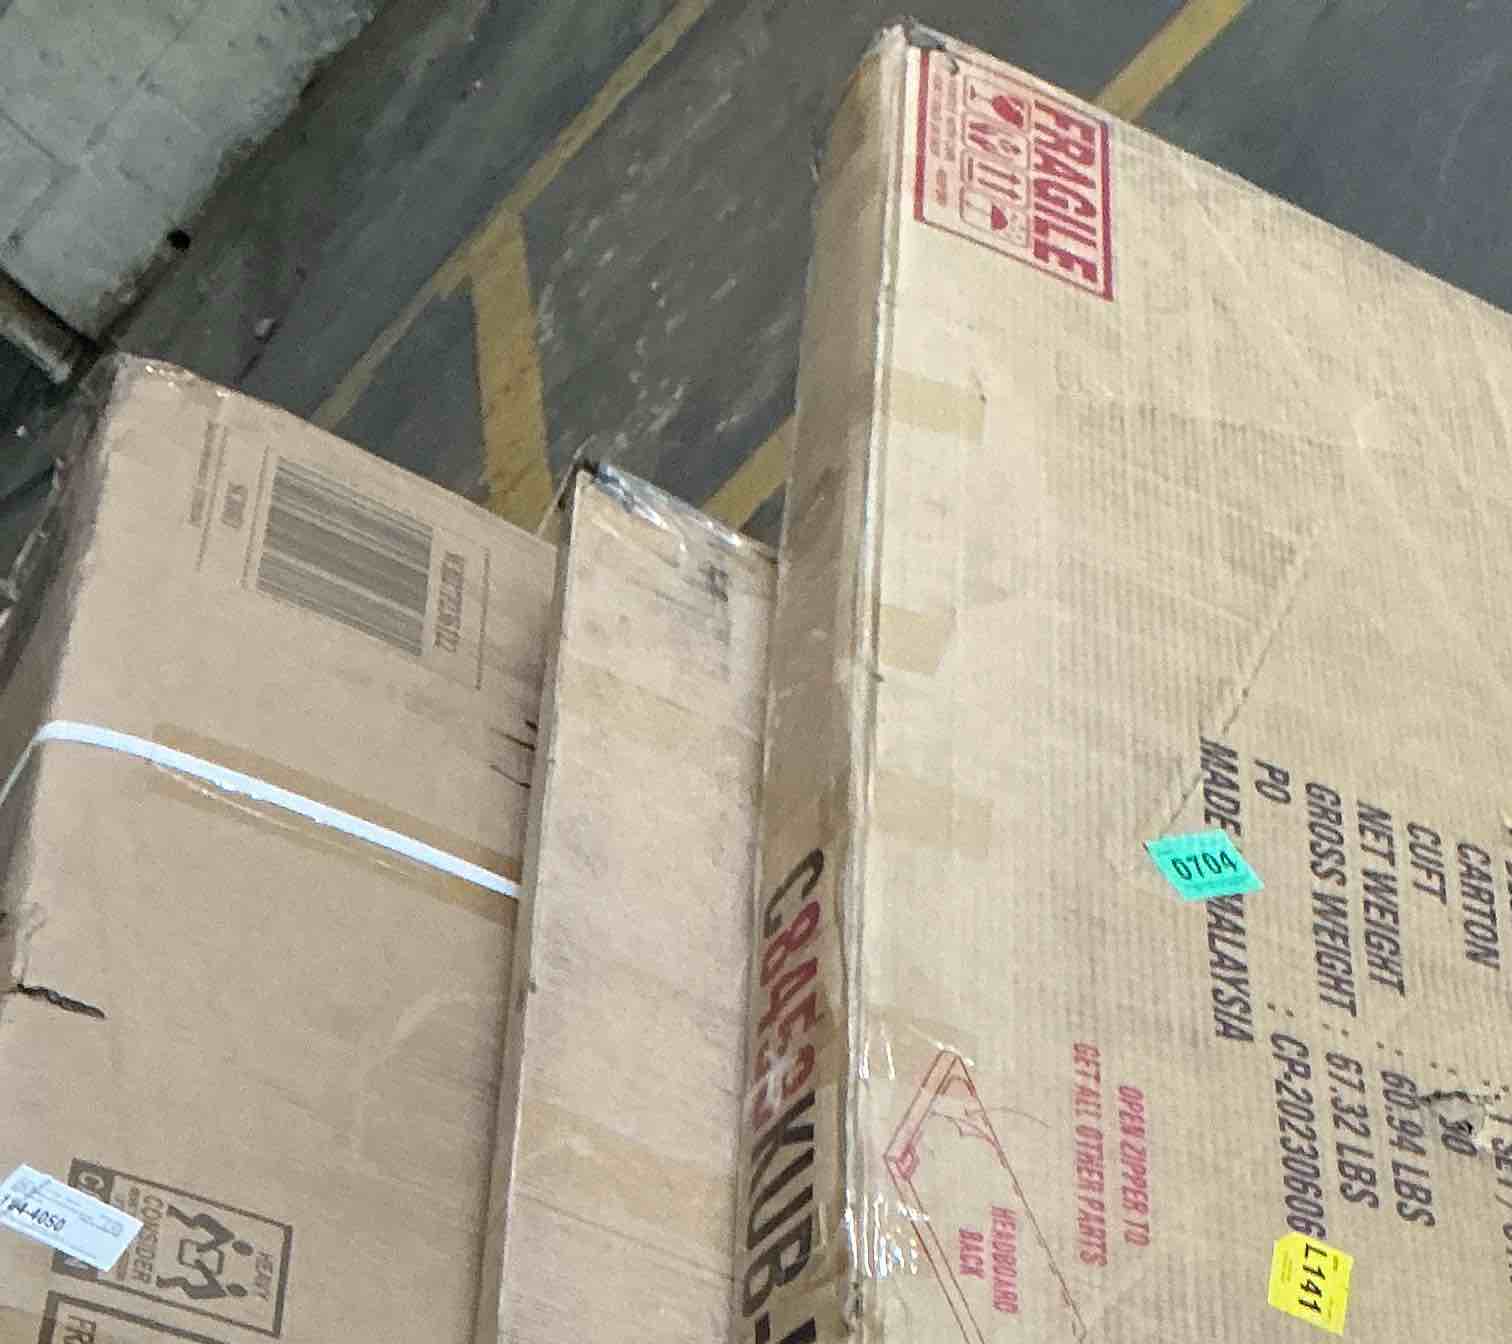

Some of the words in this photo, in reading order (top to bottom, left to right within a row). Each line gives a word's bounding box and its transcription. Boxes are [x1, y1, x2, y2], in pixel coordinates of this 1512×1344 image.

[1033, 100, 1097, 284] FRAGILE
[1200, 736, 1241, 837] MADE
[1254, 759, 1291, 804] PO
[1171, 850, 1238, 881] 0704
[1305, 782, 1346, 887] GROSS
[1357, 800, 1395, 867] NET
[1407, 822, 1447, 905] CUFT
[1362, 868, 1405, 998] WEIGHT
[1457, 843, 1500, 970] CARTON
[1312, 892, 1357, 1018] WEIGHT
[1074, 1086, 1102, 1120] ALL
[1119, 1085, 1146, 1136] OPEN
[1325, 1052, 1372, 1139] 67.32
[1076, 1125, 1104, 1192] OTHER
[1120, 1137, 1149, 1216] ZIPPER
[1336, 1141, 1379, 1208] LBS
[1391, 1160, 1435, 1227] LBS
[132, 1194, 164, 1286] CONSIDER
[959, 1231, 984, 1280] BACK
[1078, 1194, 1108, 1267] PARTS
[1123, 1219, 1151, 1248] TO
[1298, 1243, 1327, 1315] L141
